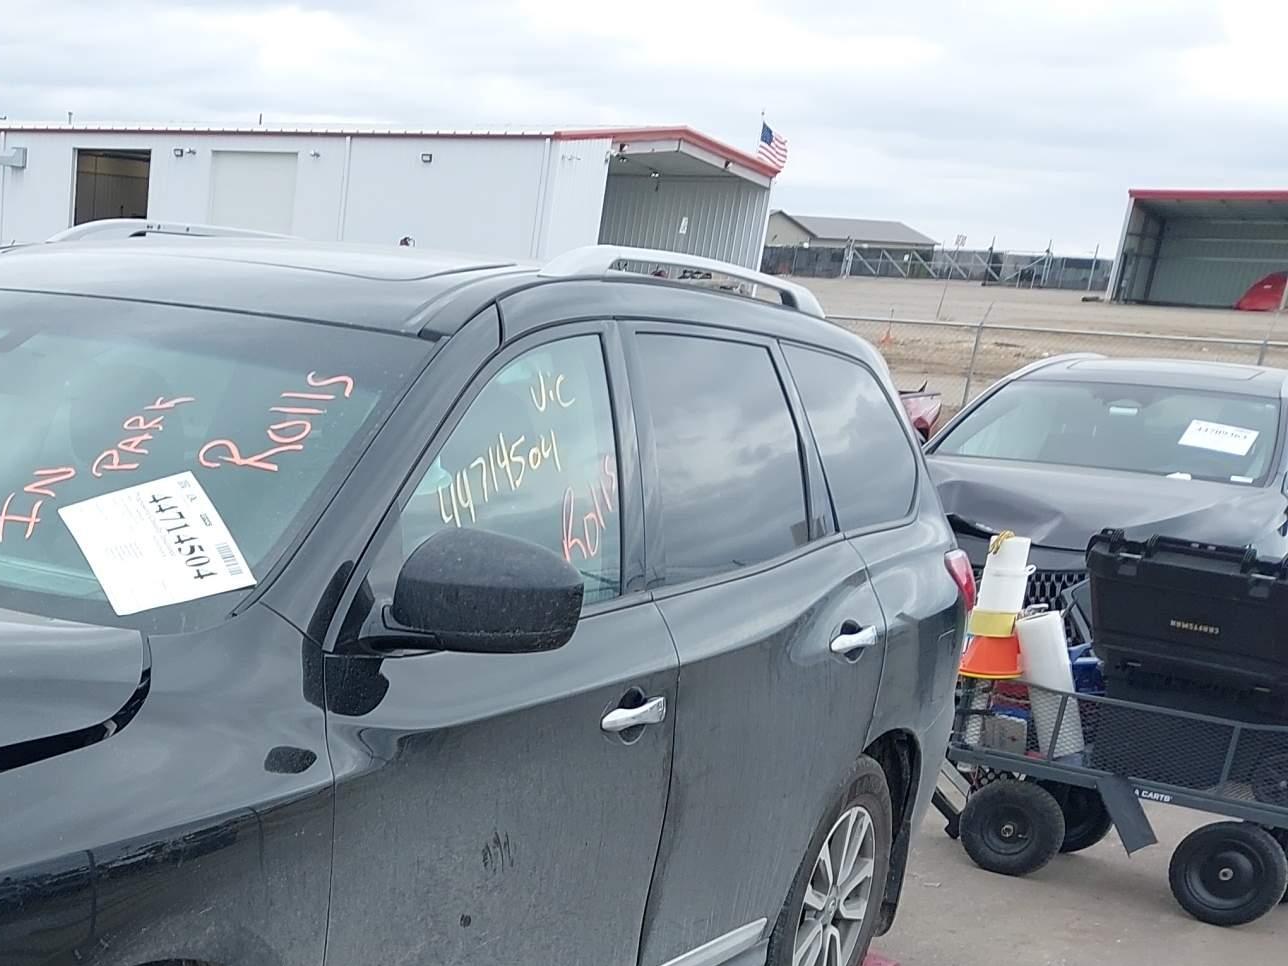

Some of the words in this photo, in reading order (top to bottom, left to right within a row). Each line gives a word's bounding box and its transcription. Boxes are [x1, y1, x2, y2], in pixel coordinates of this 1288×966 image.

[92, 395, 196, 478] PARK
[437, 428, 562, 529] 44714504
[149, 493, 218, 581] 44714504
